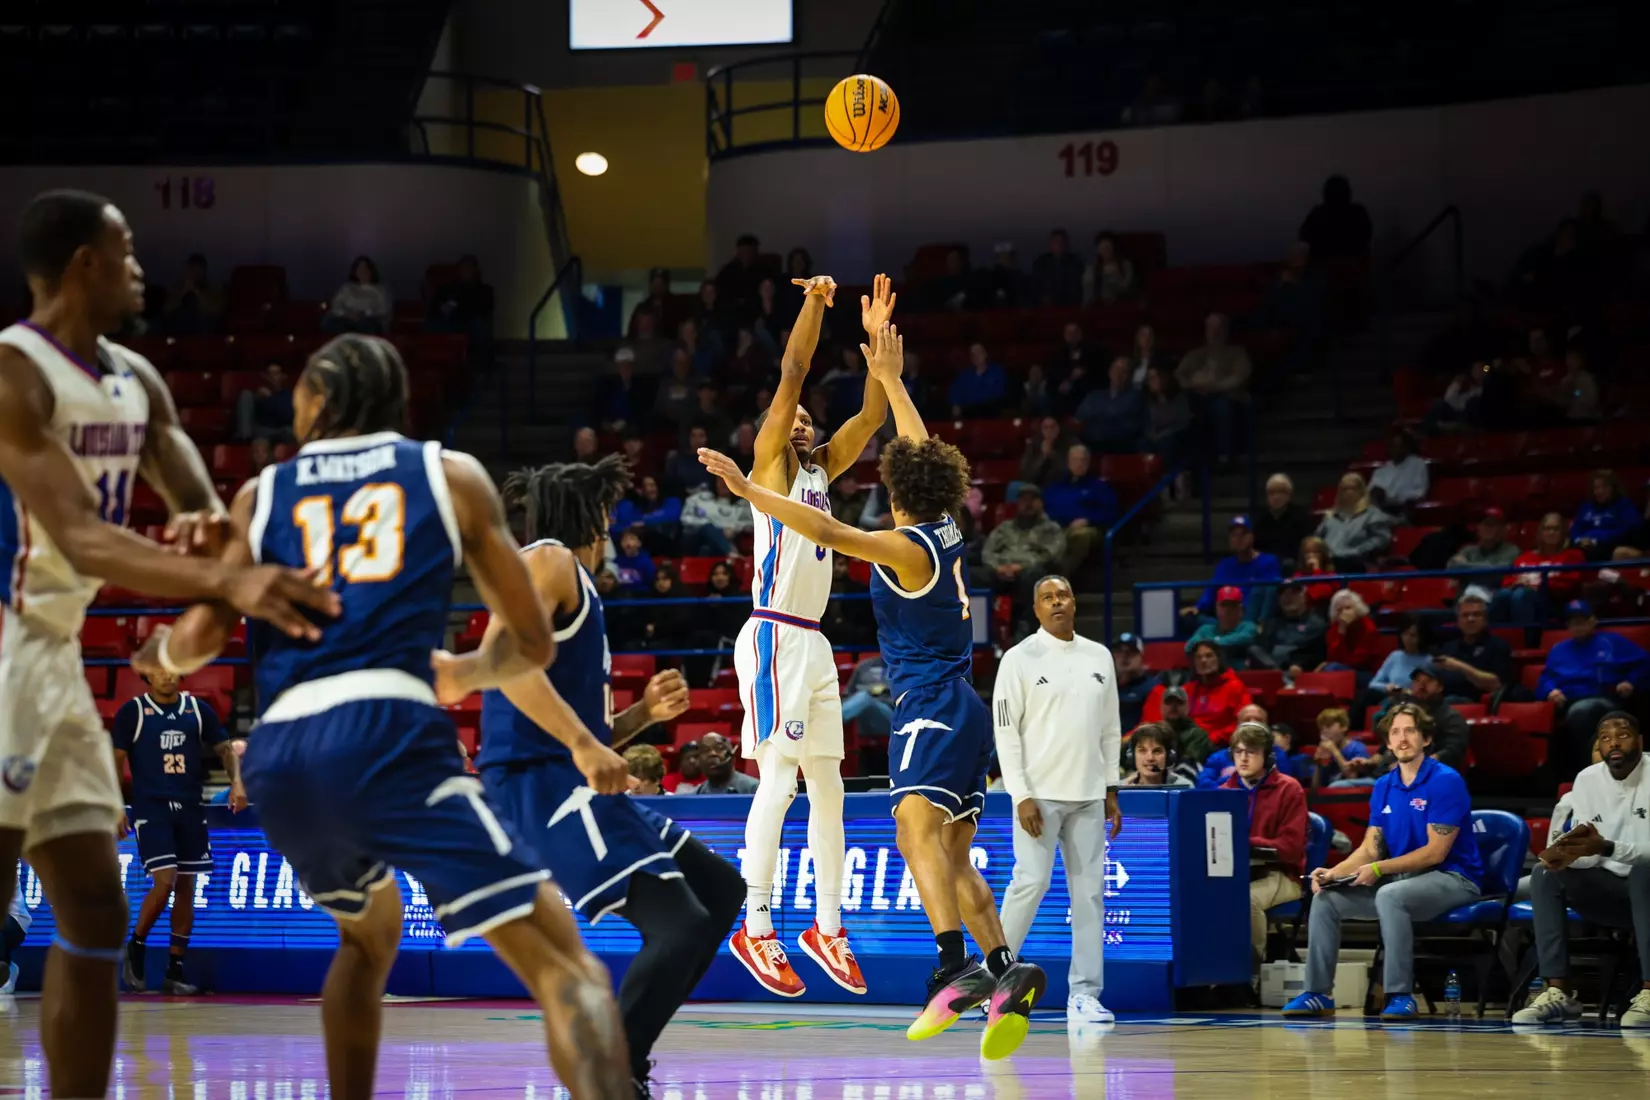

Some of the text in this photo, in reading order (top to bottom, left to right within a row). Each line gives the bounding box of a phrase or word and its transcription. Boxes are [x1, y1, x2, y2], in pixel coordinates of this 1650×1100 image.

[1058, 141, 1119, 178] 119
[154, 176, 215, 210] 118
[293, 482, 407, 588] 13
[952, 556, 971, 620] 1
[160, 730, 186, 751] UTEP
[163, 754, 186, 775] 23
